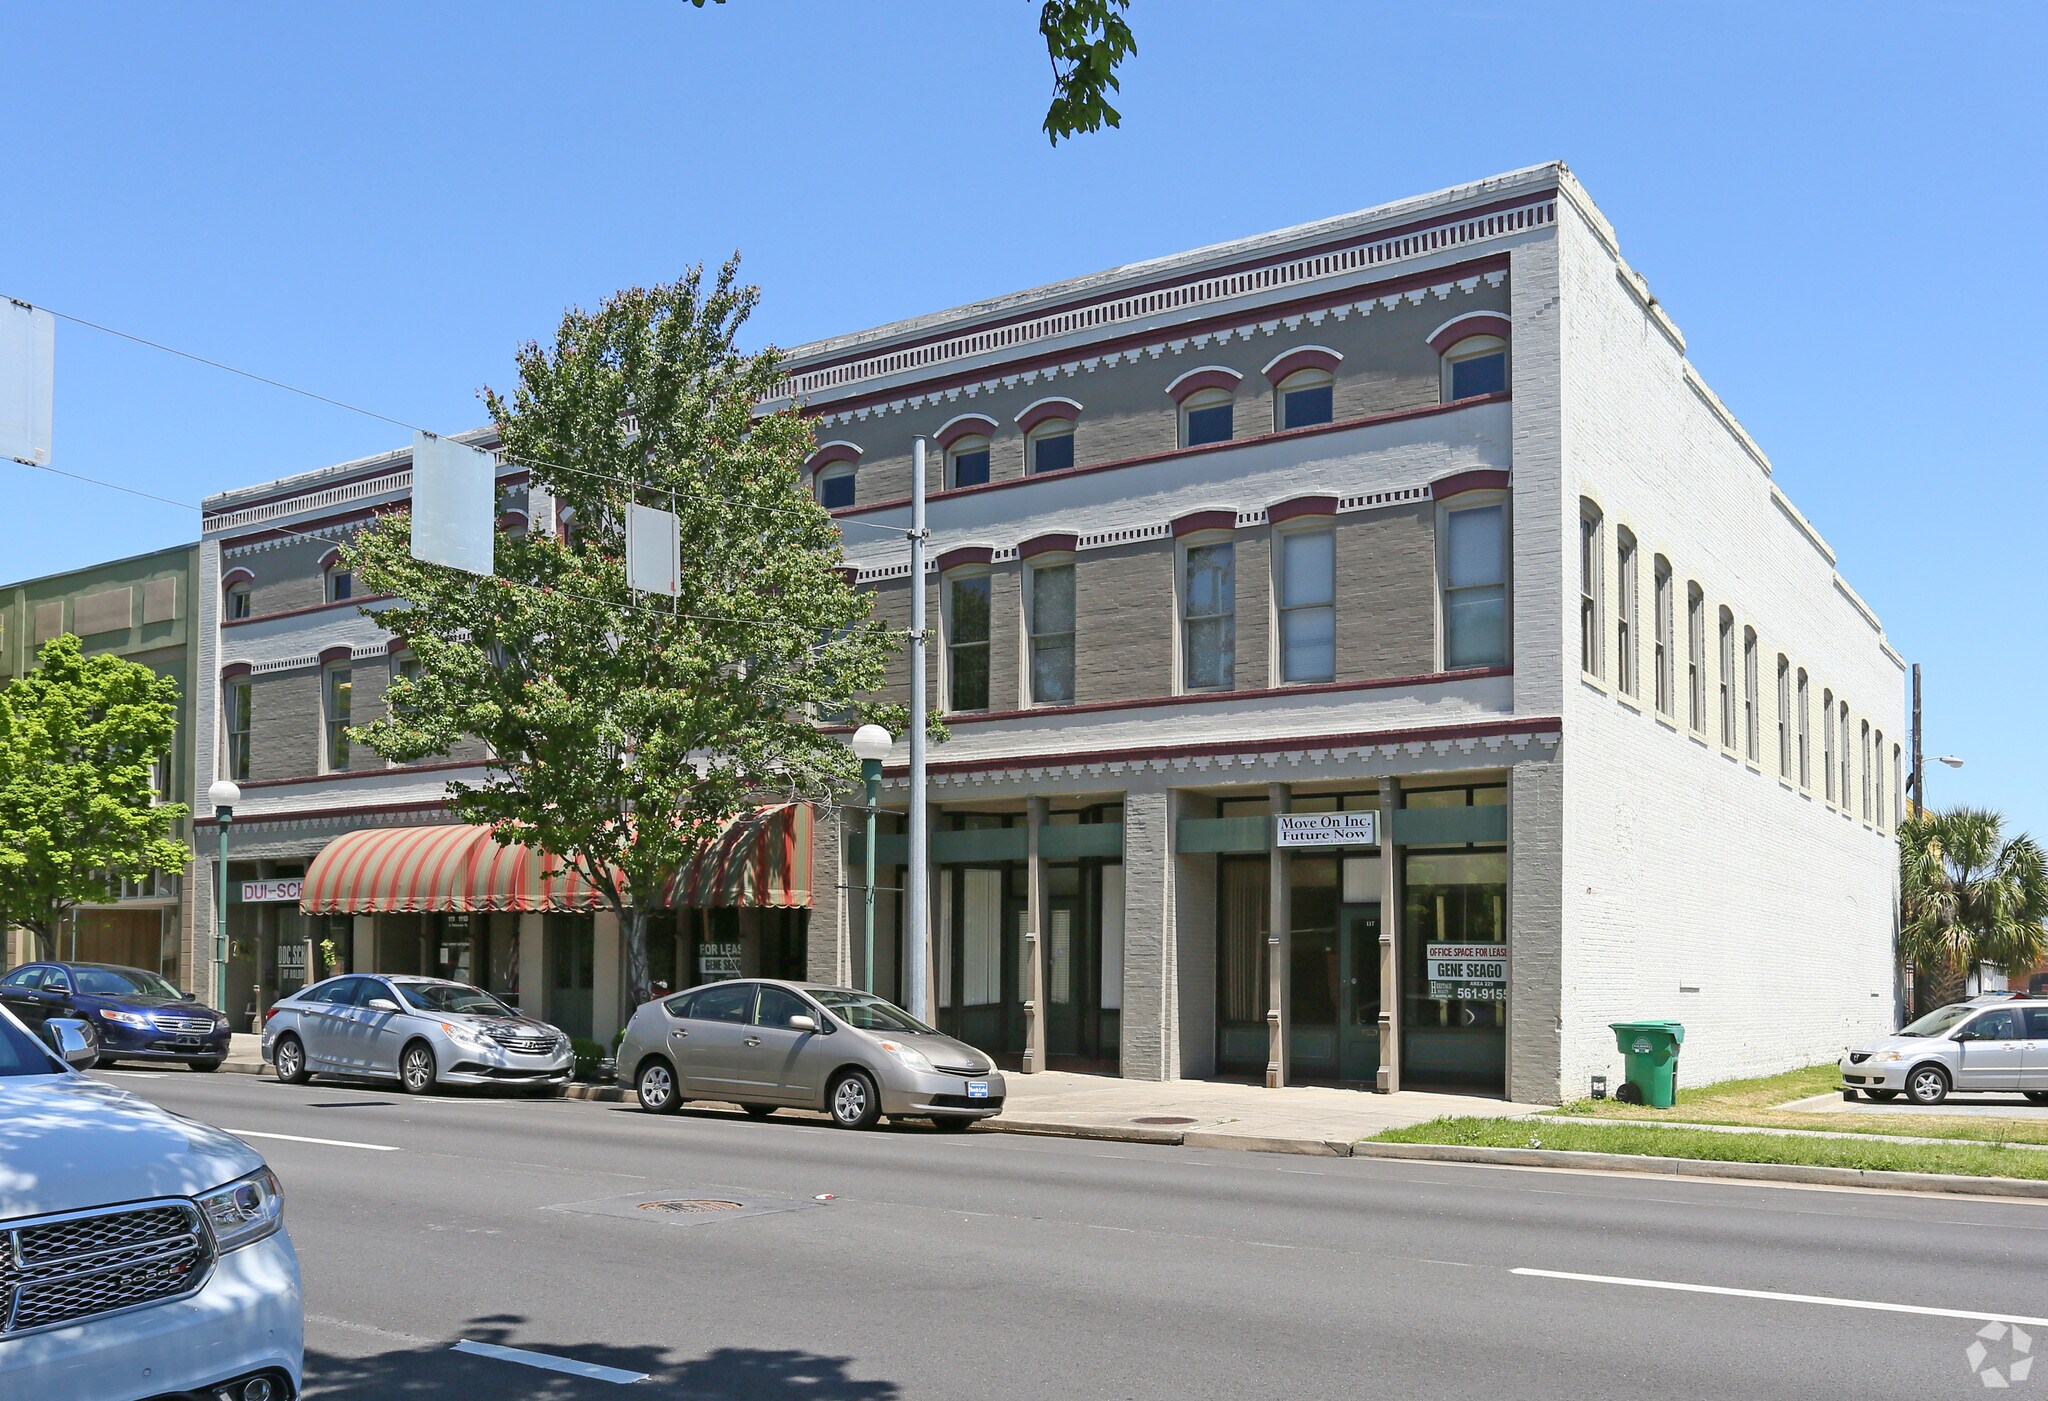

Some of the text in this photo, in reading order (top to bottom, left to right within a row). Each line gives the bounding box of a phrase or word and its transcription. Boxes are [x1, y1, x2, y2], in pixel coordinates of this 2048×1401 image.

[1281, 815, 1371, 829] Move On Inc.
[1283, 829, 1367, 841] Future Now
[278, 945, 291, 964] DDC
[700, 944, 718, 955] FOR
[1429, 948, 1452, 957] OFFICE
[1454, 948, 1474, 957] SPACE
[1475, 948, 1488, 957] FOR
[705, 959, 721, 971] GENE
[1437, 963, 1502, 978] GENE SEAGO
[120, 1267, 179, 1285] DODGE
